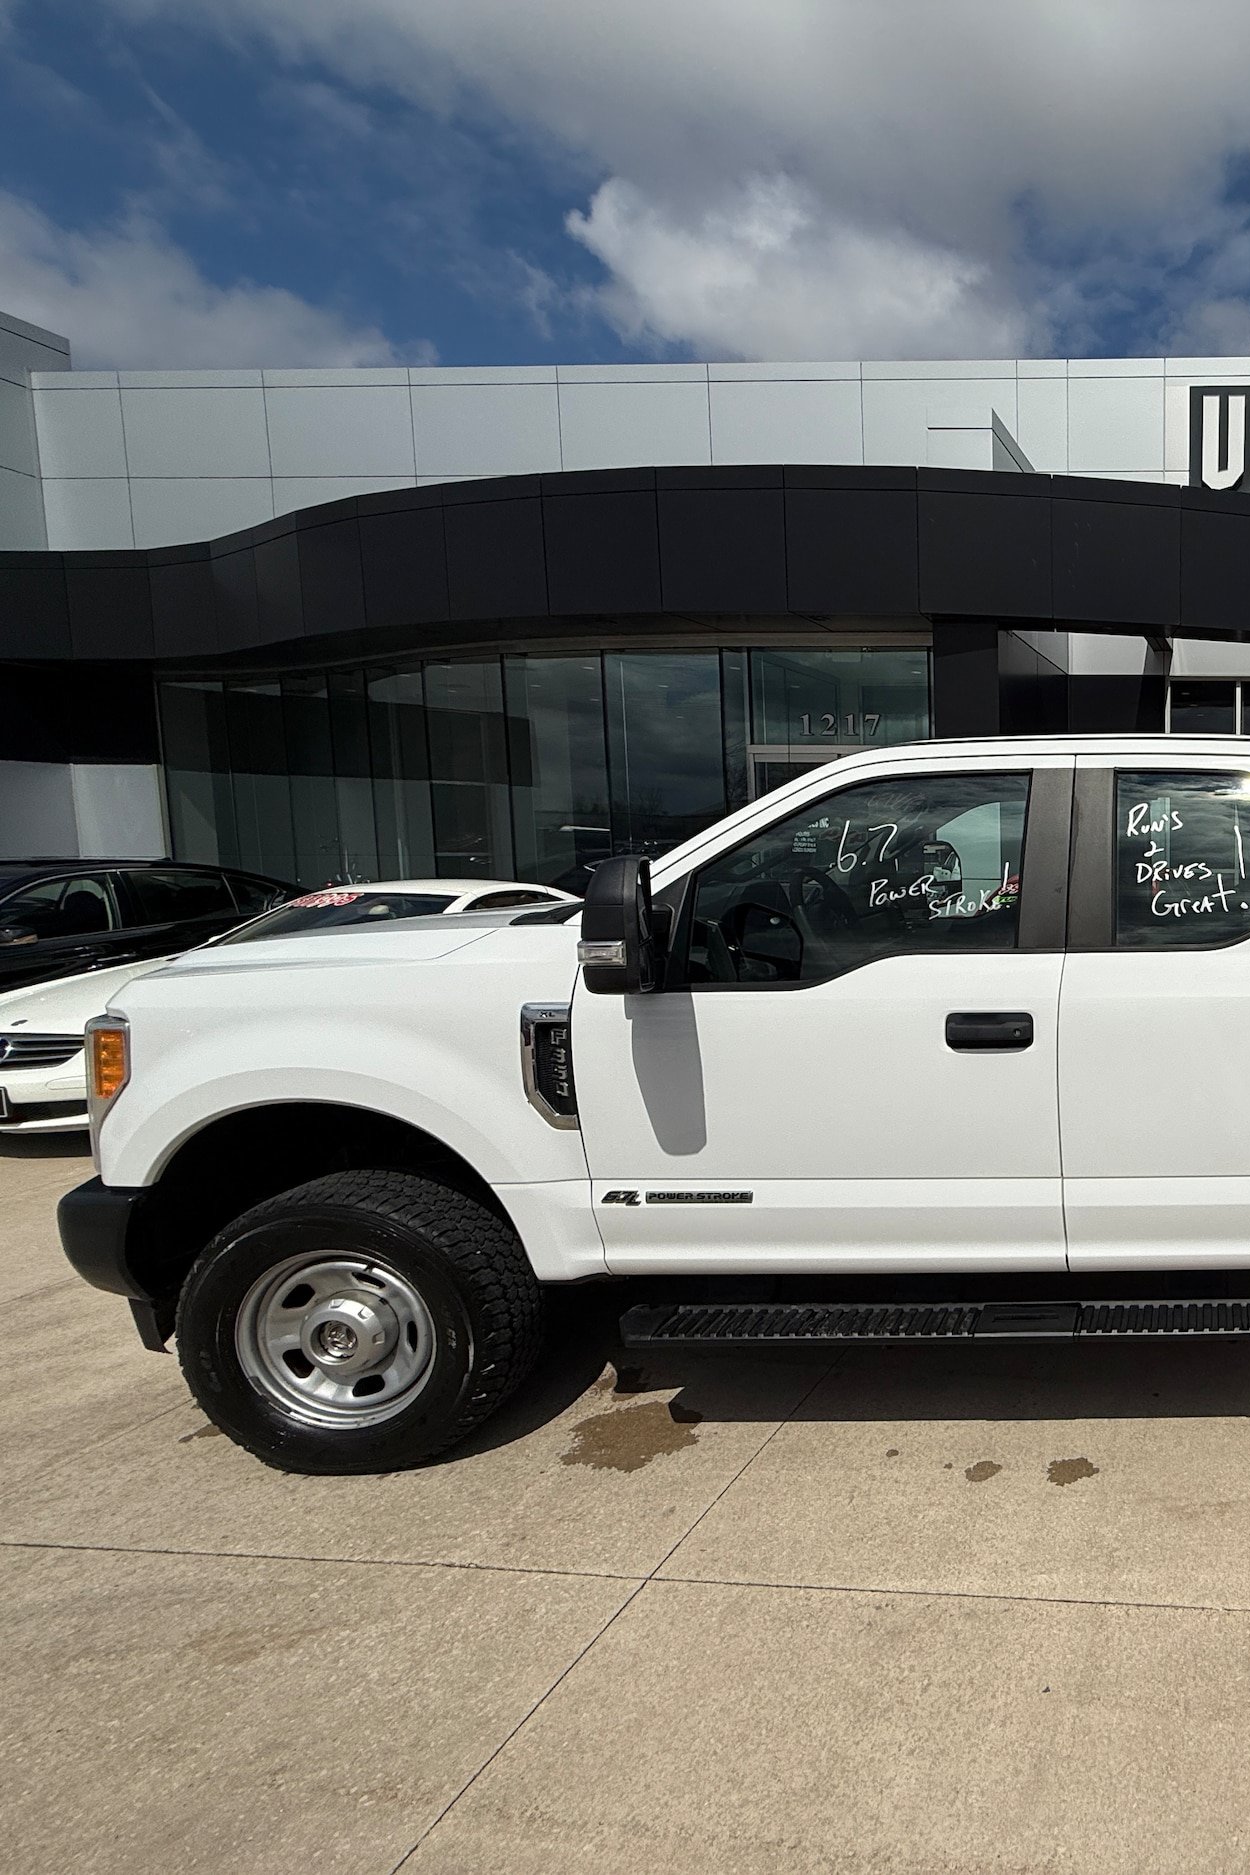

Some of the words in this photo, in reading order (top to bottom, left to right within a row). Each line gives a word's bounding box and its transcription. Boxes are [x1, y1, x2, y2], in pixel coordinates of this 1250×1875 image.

[800, 713, 880, 736] 1217
[648, 1192, 694, 1200] POWER
[696, 1192, 749, 1200] STROKE
